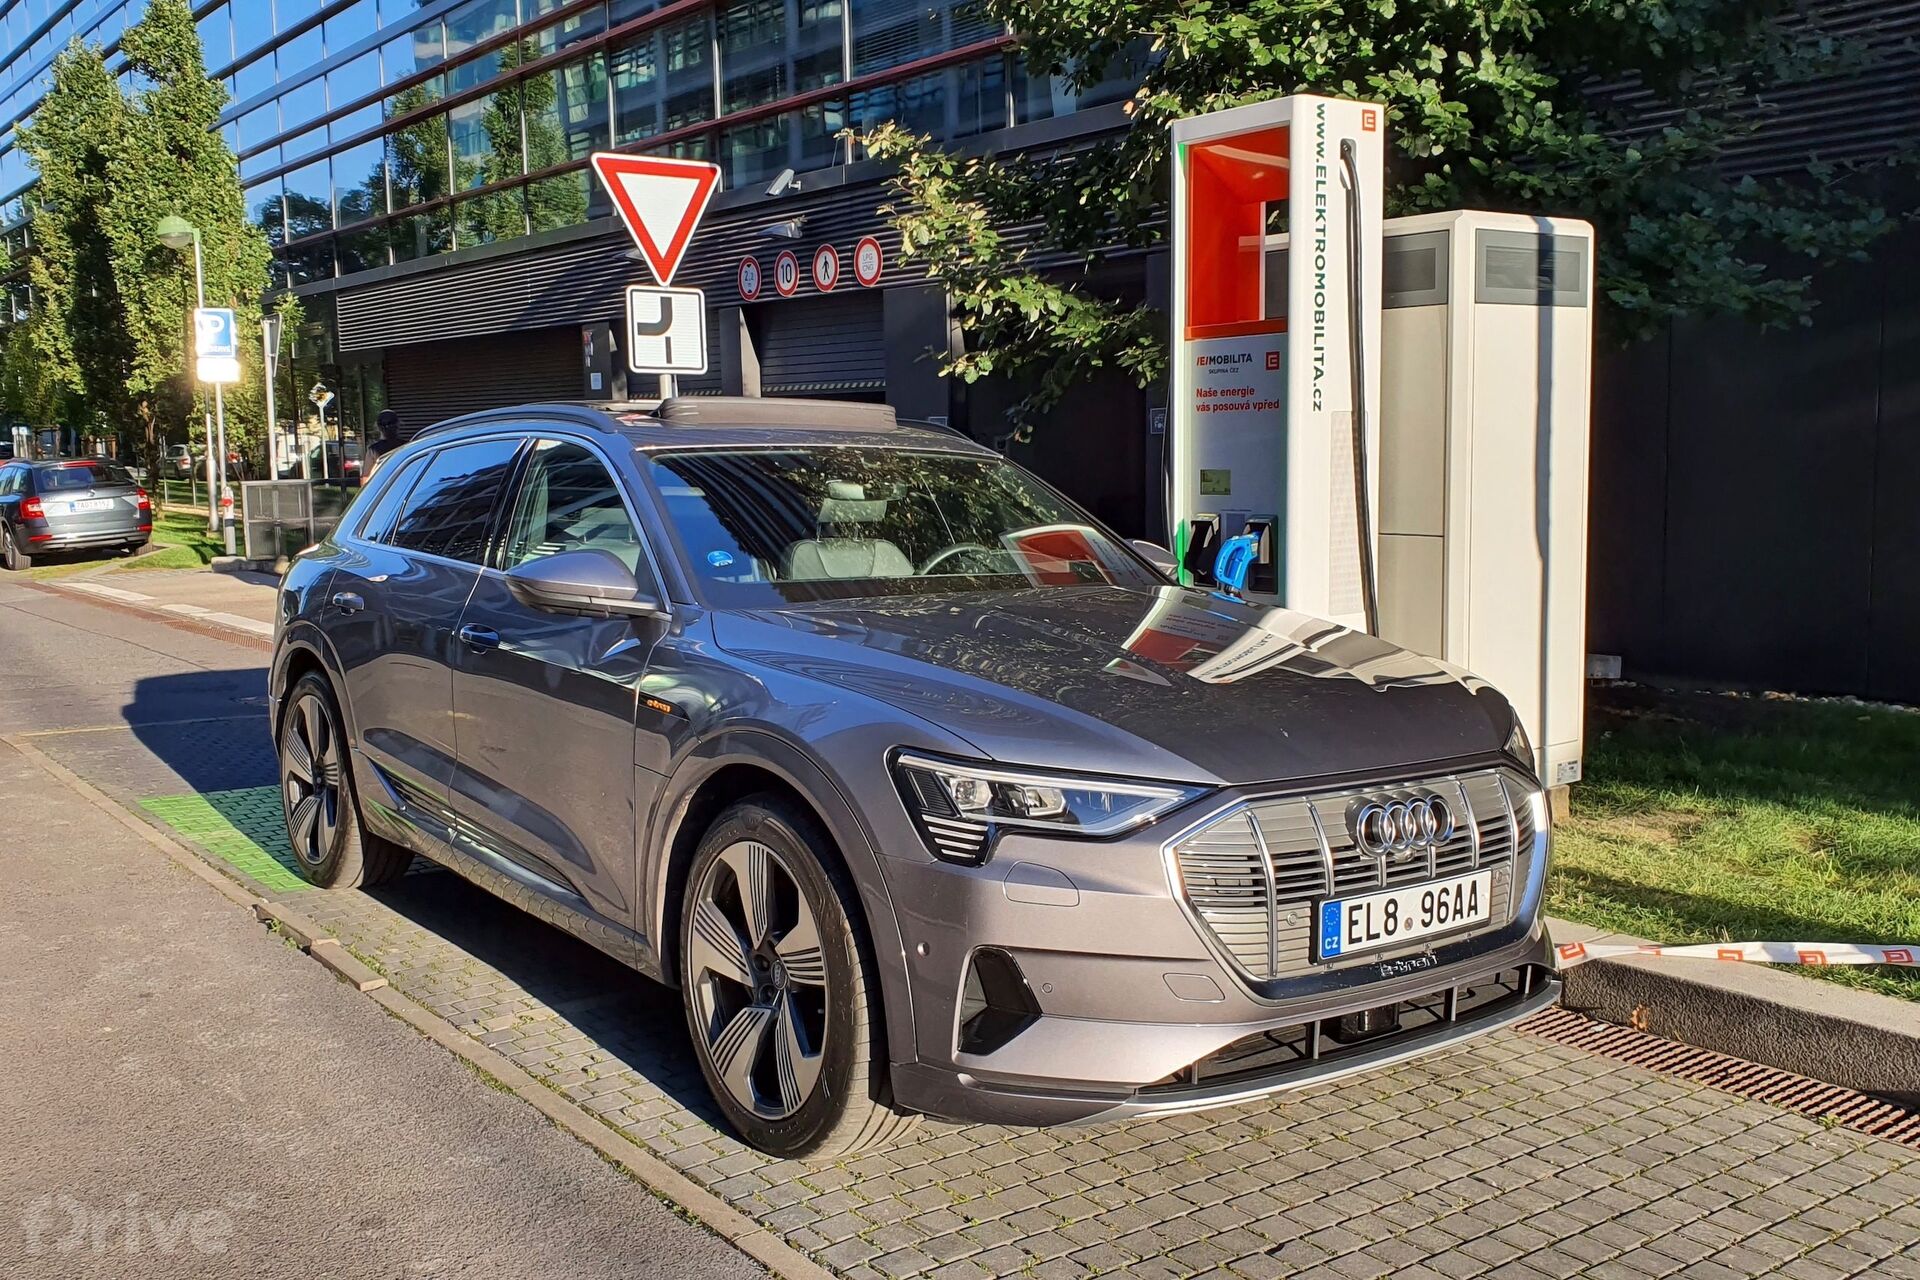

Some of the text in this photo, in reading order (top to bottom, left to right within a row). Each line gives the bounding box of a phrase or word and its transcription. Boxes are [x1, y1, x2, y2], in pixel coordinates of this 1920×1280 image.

[862, 252, 873, 261] LPG
[1313, 103, 1328, 412] www.ELEKTROMOBILITA.cz
[781, 263, 792, 284] 10
[862, 264, 874, 273] CNG
[1196, 386, 1255, 398] Naše energie
[1195, 399, 1279, 413] vás posouvá vpřed
[1348, 880, 1479, 945] EL8 96AA
[1325, 936, 1339, 950] CZ
